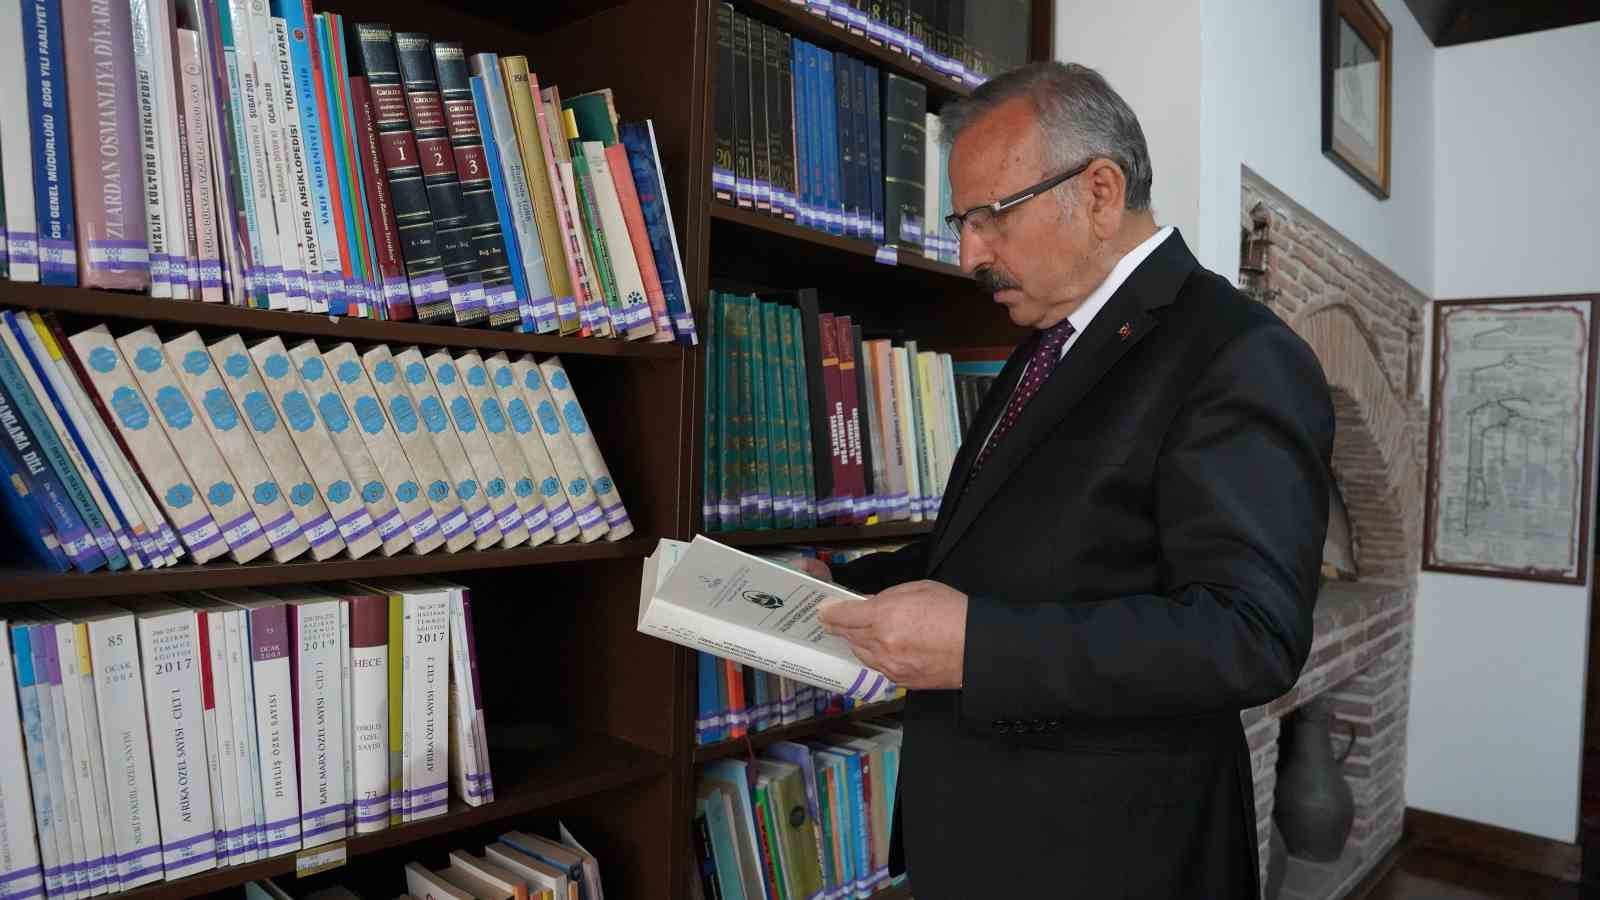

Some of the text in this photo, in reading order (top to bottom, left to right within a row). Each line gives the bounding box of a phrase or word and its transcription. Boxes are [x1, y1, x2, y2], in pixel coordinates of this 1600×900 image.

[872, 4, 881, 20] 8
[35, 3, 50, 54] FAALİYET
[40, 57, 51, 78] YILI
[41, 80, 53, 109] 2006
[246, 73, 256, 92] 2018
[97, 59, 119, 155] OSMANLIYA
[141, 70, 155, 148] ANSİKLOPEDİSİ
[248, 94, 258, 118] ŞUBAT
[266, 103, 276, 124] OCAK
[45, 114, 58, 182] MÜDÜRLÜĞÜ
[276, 23, 318, 266] ALIŞVERİŞ ANSİKLOPEDİSİ TÜKETİCİ VAKFI
[308, 125, 325, 188] MEDENİYETİ
[398, 147, 407, 161] 1
[433, 152, 445, 167] 2
[468, 159, 479, 175] 3
[715, 148, 732, 169] 20
[147, 153, 160, 205] KÜLTÜRÜ
[49, 184, 60, 217] GENEL
[318, 189, 330, 224] VAKIF
[23, 450, 45, 475] DİLİ
[107, 634, 124, 647] 85
[303, 639, 335, 652] 2019
[416, 631, 446, 645] 2017
[104, 663, 132, 674] OCAK
[155, 658, 193, 675] 2017
[353, 656, 383, 669] HECE
[426, 664, 435, 683] CİLT
[315, 668, 325, 690] CİLT
[172, 695, 186, 720] CİLT
[316, 697, 326, 725] SAYISI
[426, 690, 435, 715] SAYISI
[173, 727, 187, 757] SAYISI
[317, 728, 327, 751] ÖZEL
[426, 718, 435, 741] ÖZEL
[121, 730, 135, 761] SAYISI
[268, 693, 285, 797] DİRİLİŞ ÖZEL SAYISI
[426, 741, 435, 772] AFRİKA
[126, 761, 138, 787] ÖZEL
[176, 757, 190, 787] ÖZEL
[318, 752, 328, 780] MARX
[319, 781, 328, 805] KARL
[365, 790, 378, 801] 73
[178, 790, 193, 823] AFRİKA
